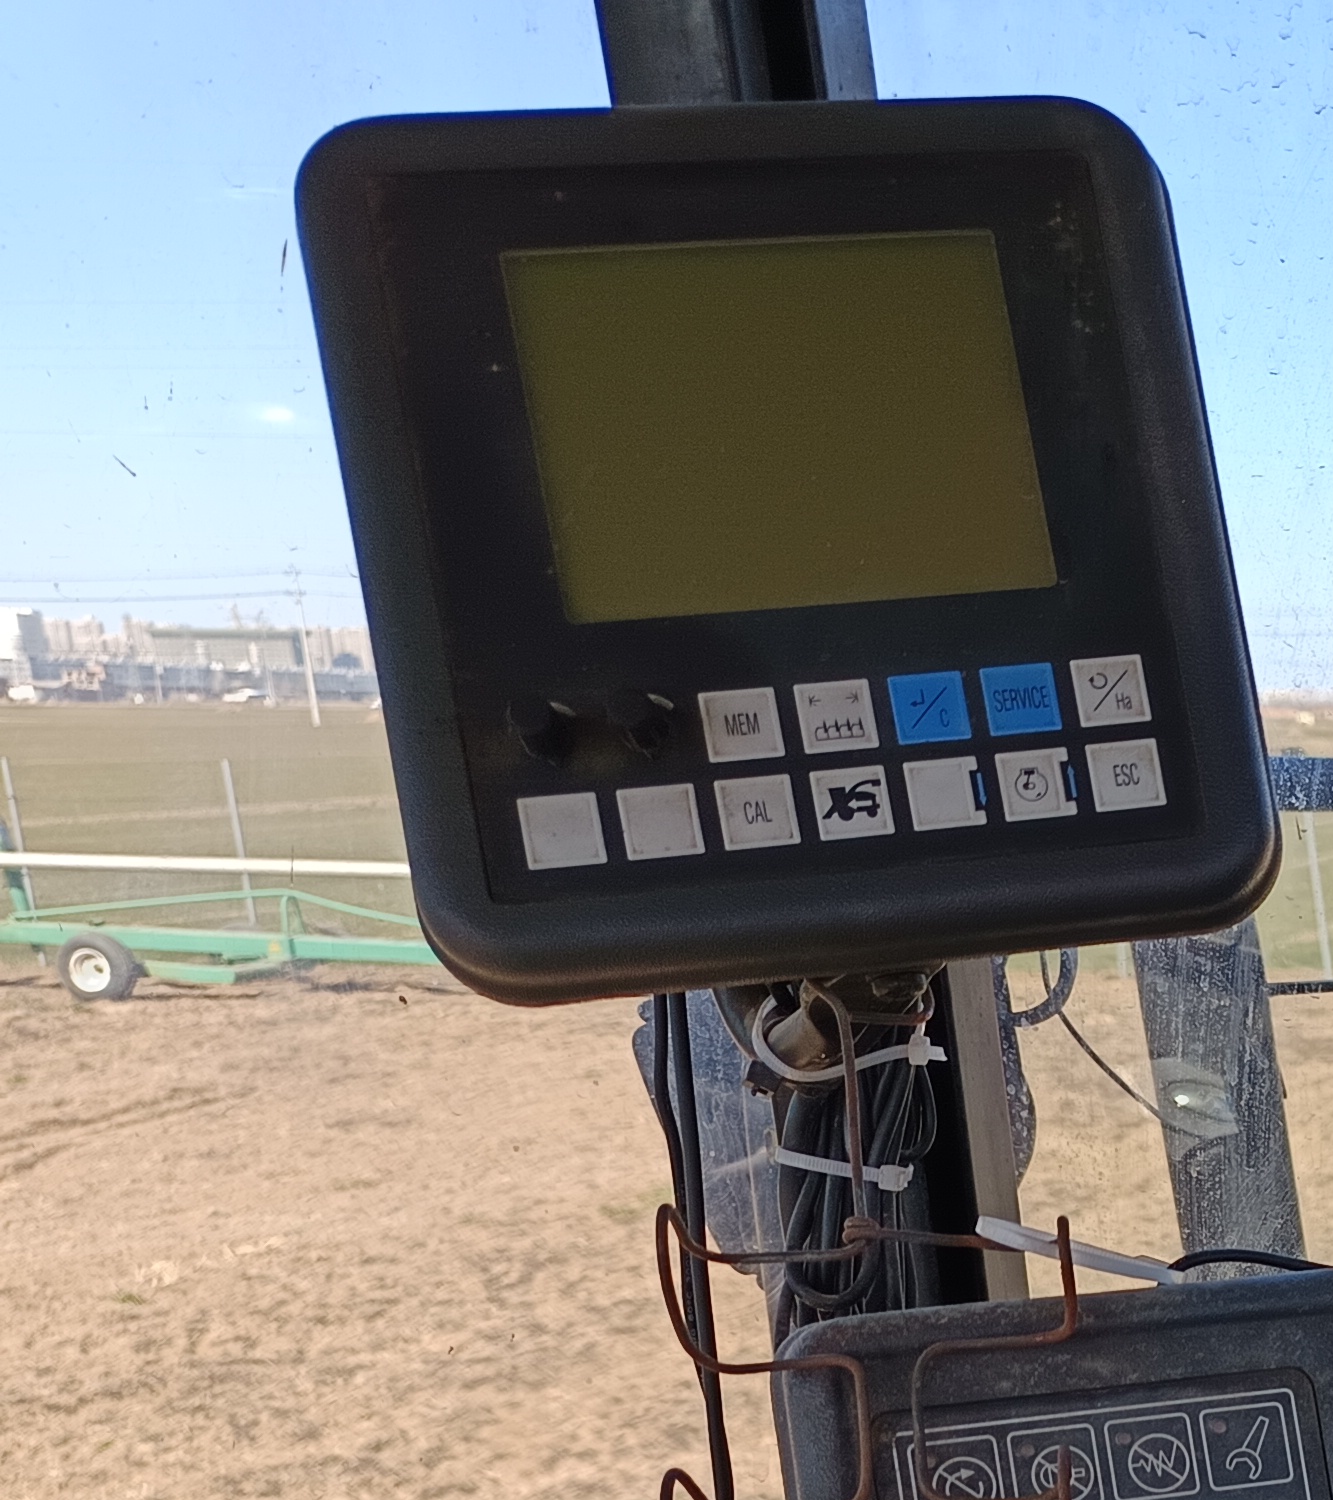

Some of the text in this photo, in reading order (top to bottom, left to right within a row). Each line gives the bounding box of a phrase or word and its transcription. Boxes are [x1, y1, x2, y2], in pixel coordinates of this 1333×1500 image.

[993, 685, 1050, 713] SERVICE
[1115, 692, 1133, 711] Ha
[724, 712, 760, 736] MEM
[939, 708, 950, 728] C
[1112, 762, 1140, 787] ESC
[743, 801, 773, 824] CAL
